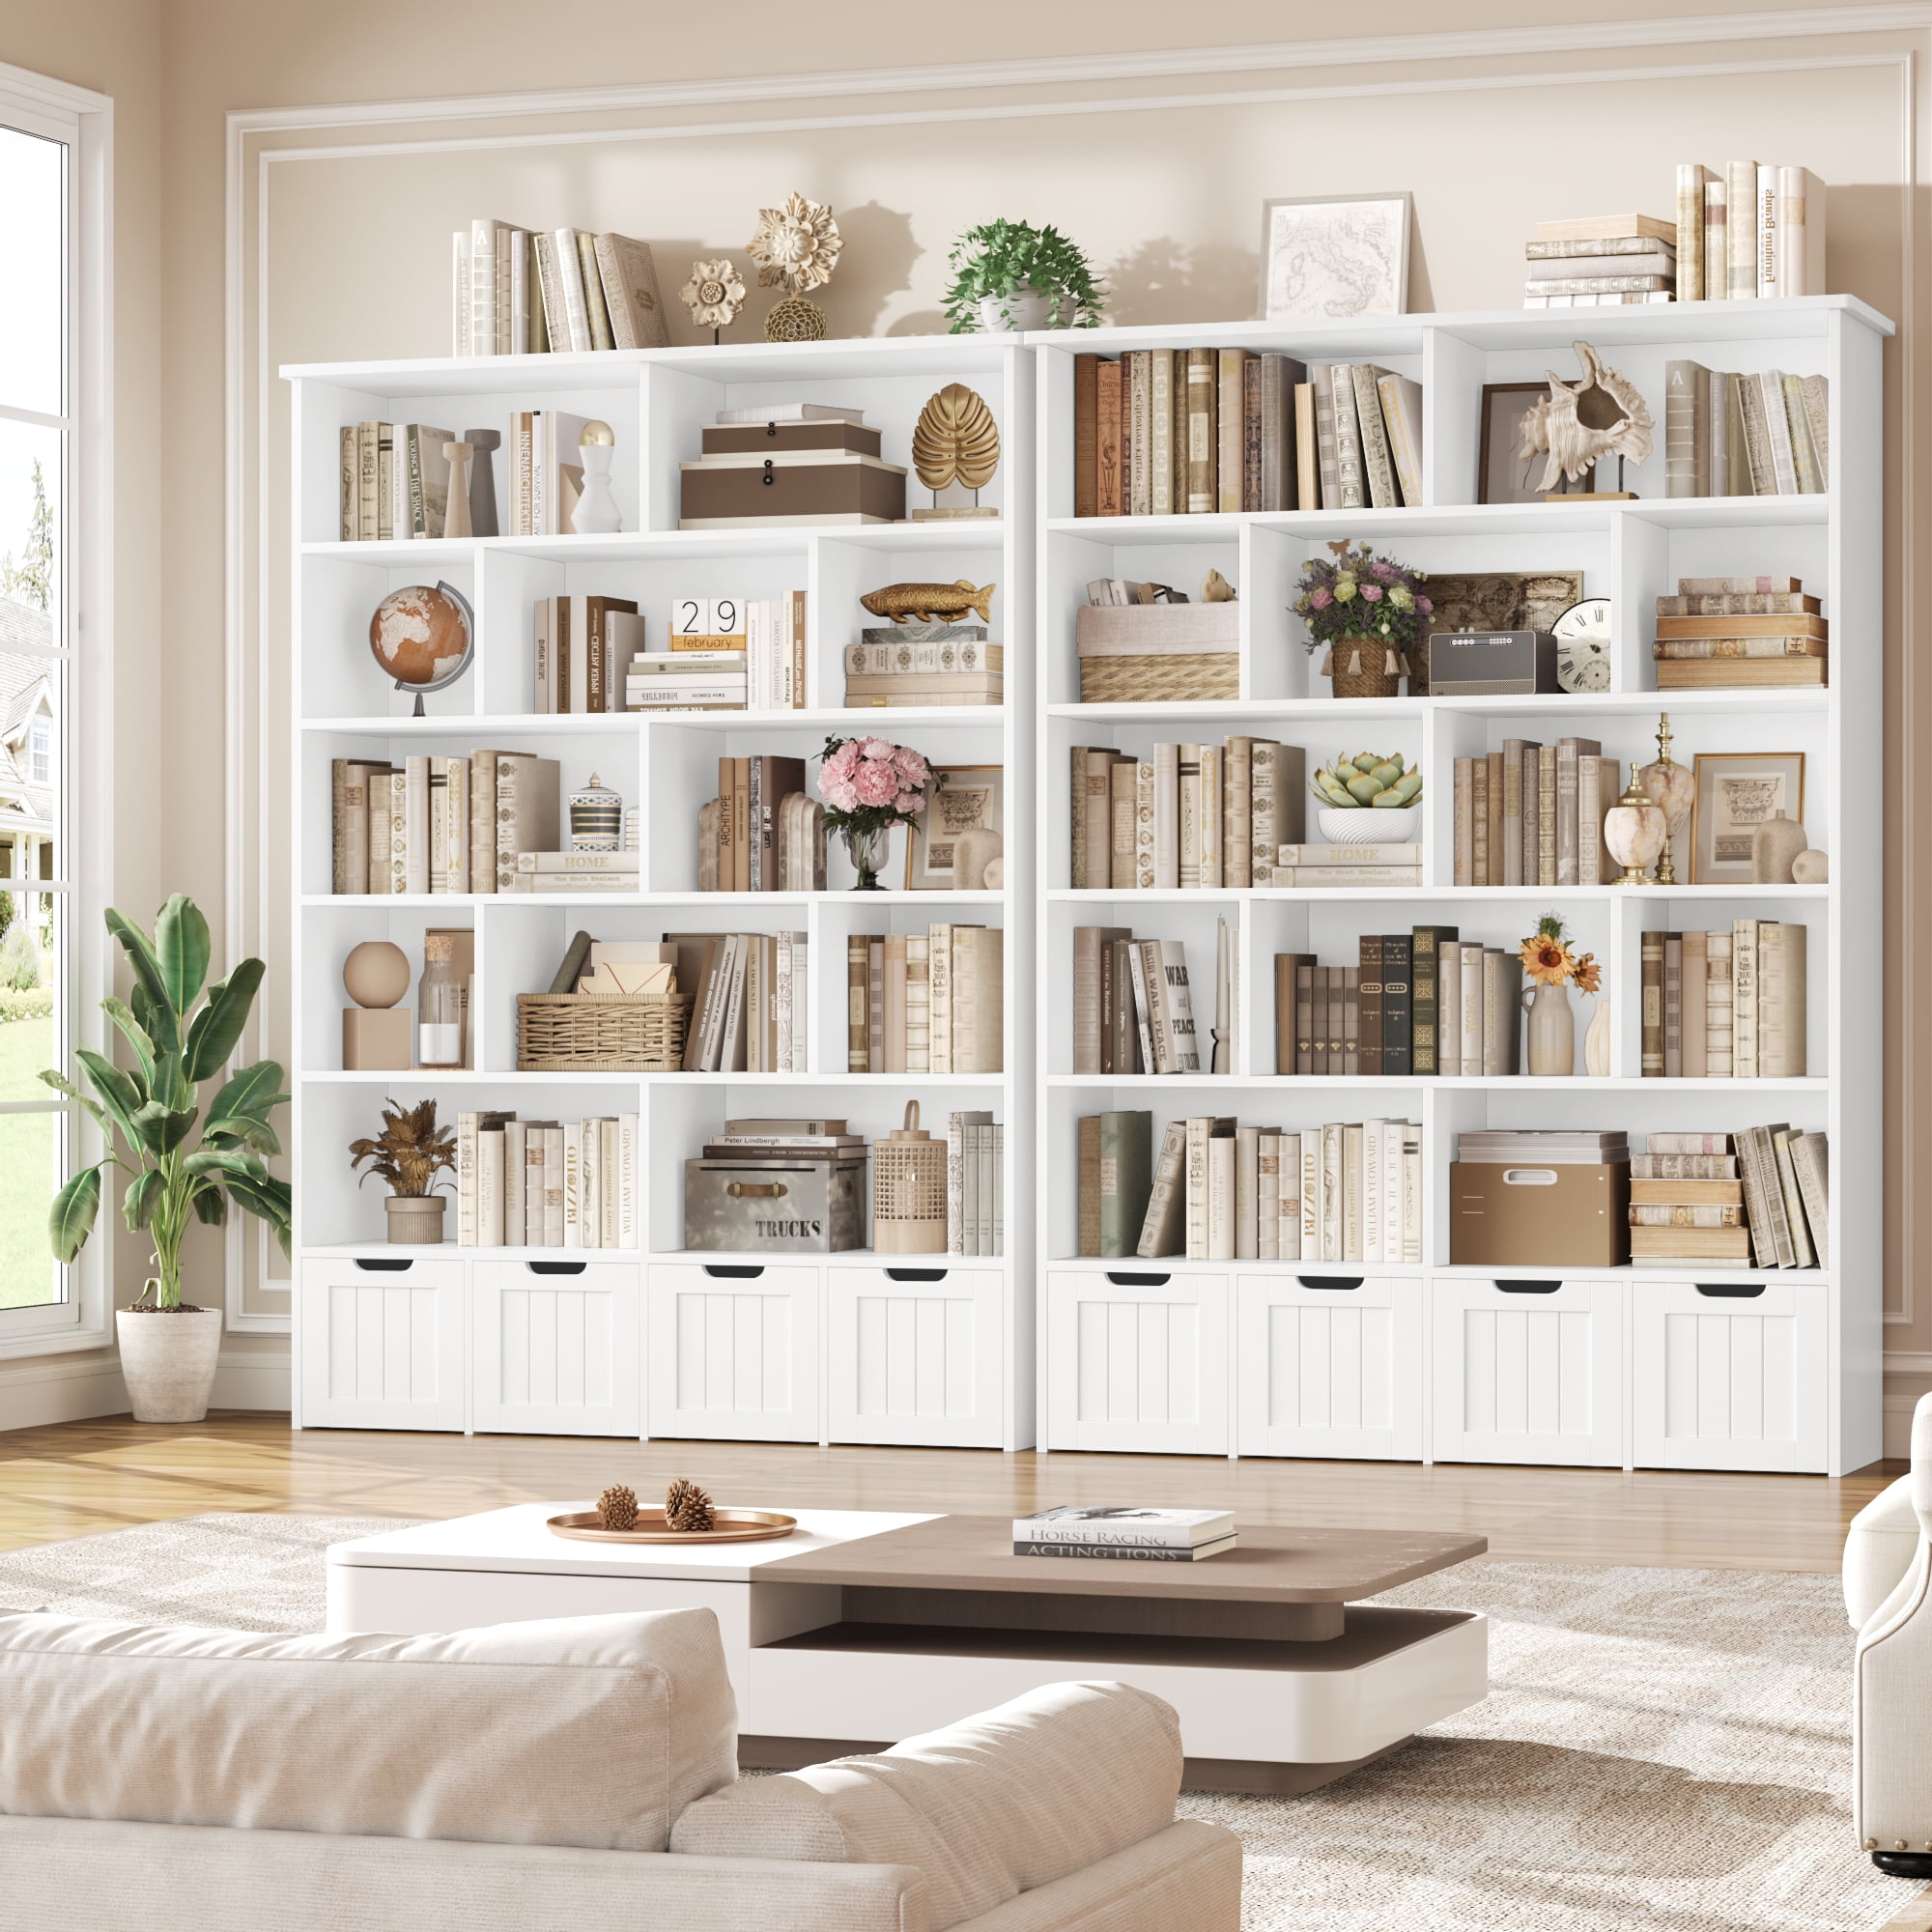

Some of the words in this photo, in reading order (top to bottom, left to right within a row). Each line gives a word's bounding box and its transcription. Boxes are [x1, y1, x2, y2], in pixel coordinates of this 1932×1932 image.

[683, 638, 732, 649] february
[721, 794, 731, 846] ARCHITYPE
[565, 857, 608, 867] HOME
[1330, 849, 1378, 861] HOME
[751, 953, 756, 964] ON
[1165, 966, 1189, 986] WAR
[705, 989, 714, 1009] GOOD
[1148, 979, 1159, 1008] WAR
[1155, 1019, 1167, 1062] PEACE
[1172, 1019, 1196, 1035] PEACE
[1368, 1135, 1377, 1192] YEOWARD
[755, 1220, 821, 1237] TRUCKS
[1368, 1197, 1377, 1245] WILLIAM
[1031, 1529, 1091, 1543] HORSE
[1096, 1532, 1167, 1547] RACING
[1028, 1546, 1108, 1558] ACTING
[1116, 1548, 1178, 1561] LIONS
